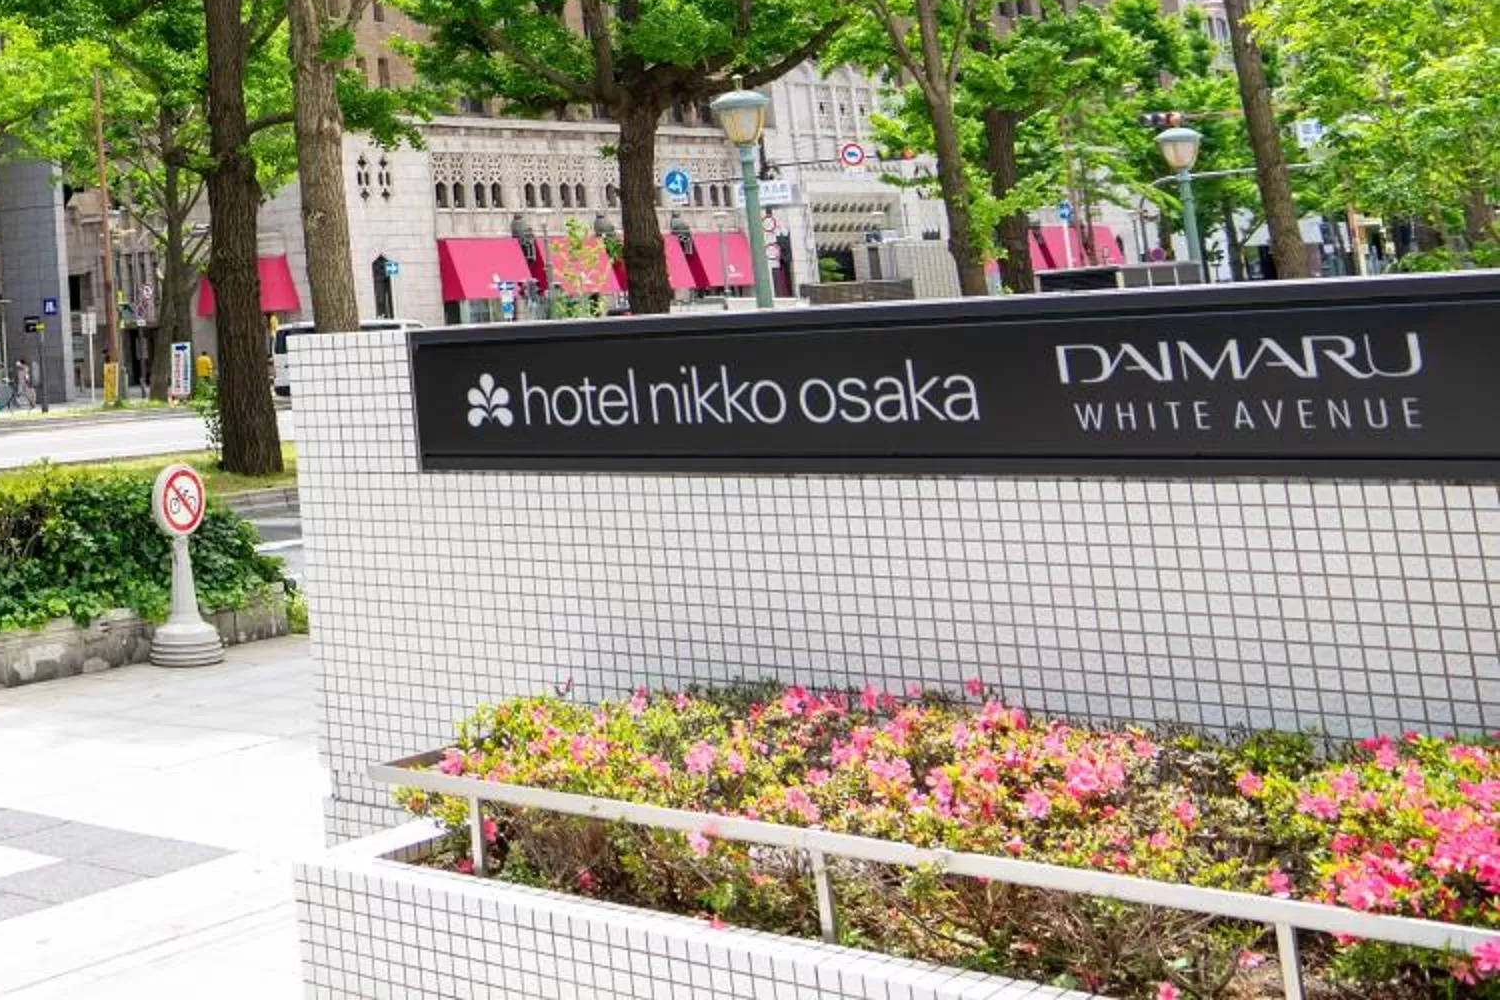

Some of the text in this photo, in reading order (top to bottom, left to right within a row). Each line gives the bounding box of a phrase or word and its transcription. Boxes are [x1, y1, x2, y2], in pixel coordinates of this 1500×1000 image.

[1054, 331, 1424, 384] DAIMARU
[520, 358, 981, 426] hotel nikko osaka
[1074, 396, 1424, 431] WHITE AVENUE
